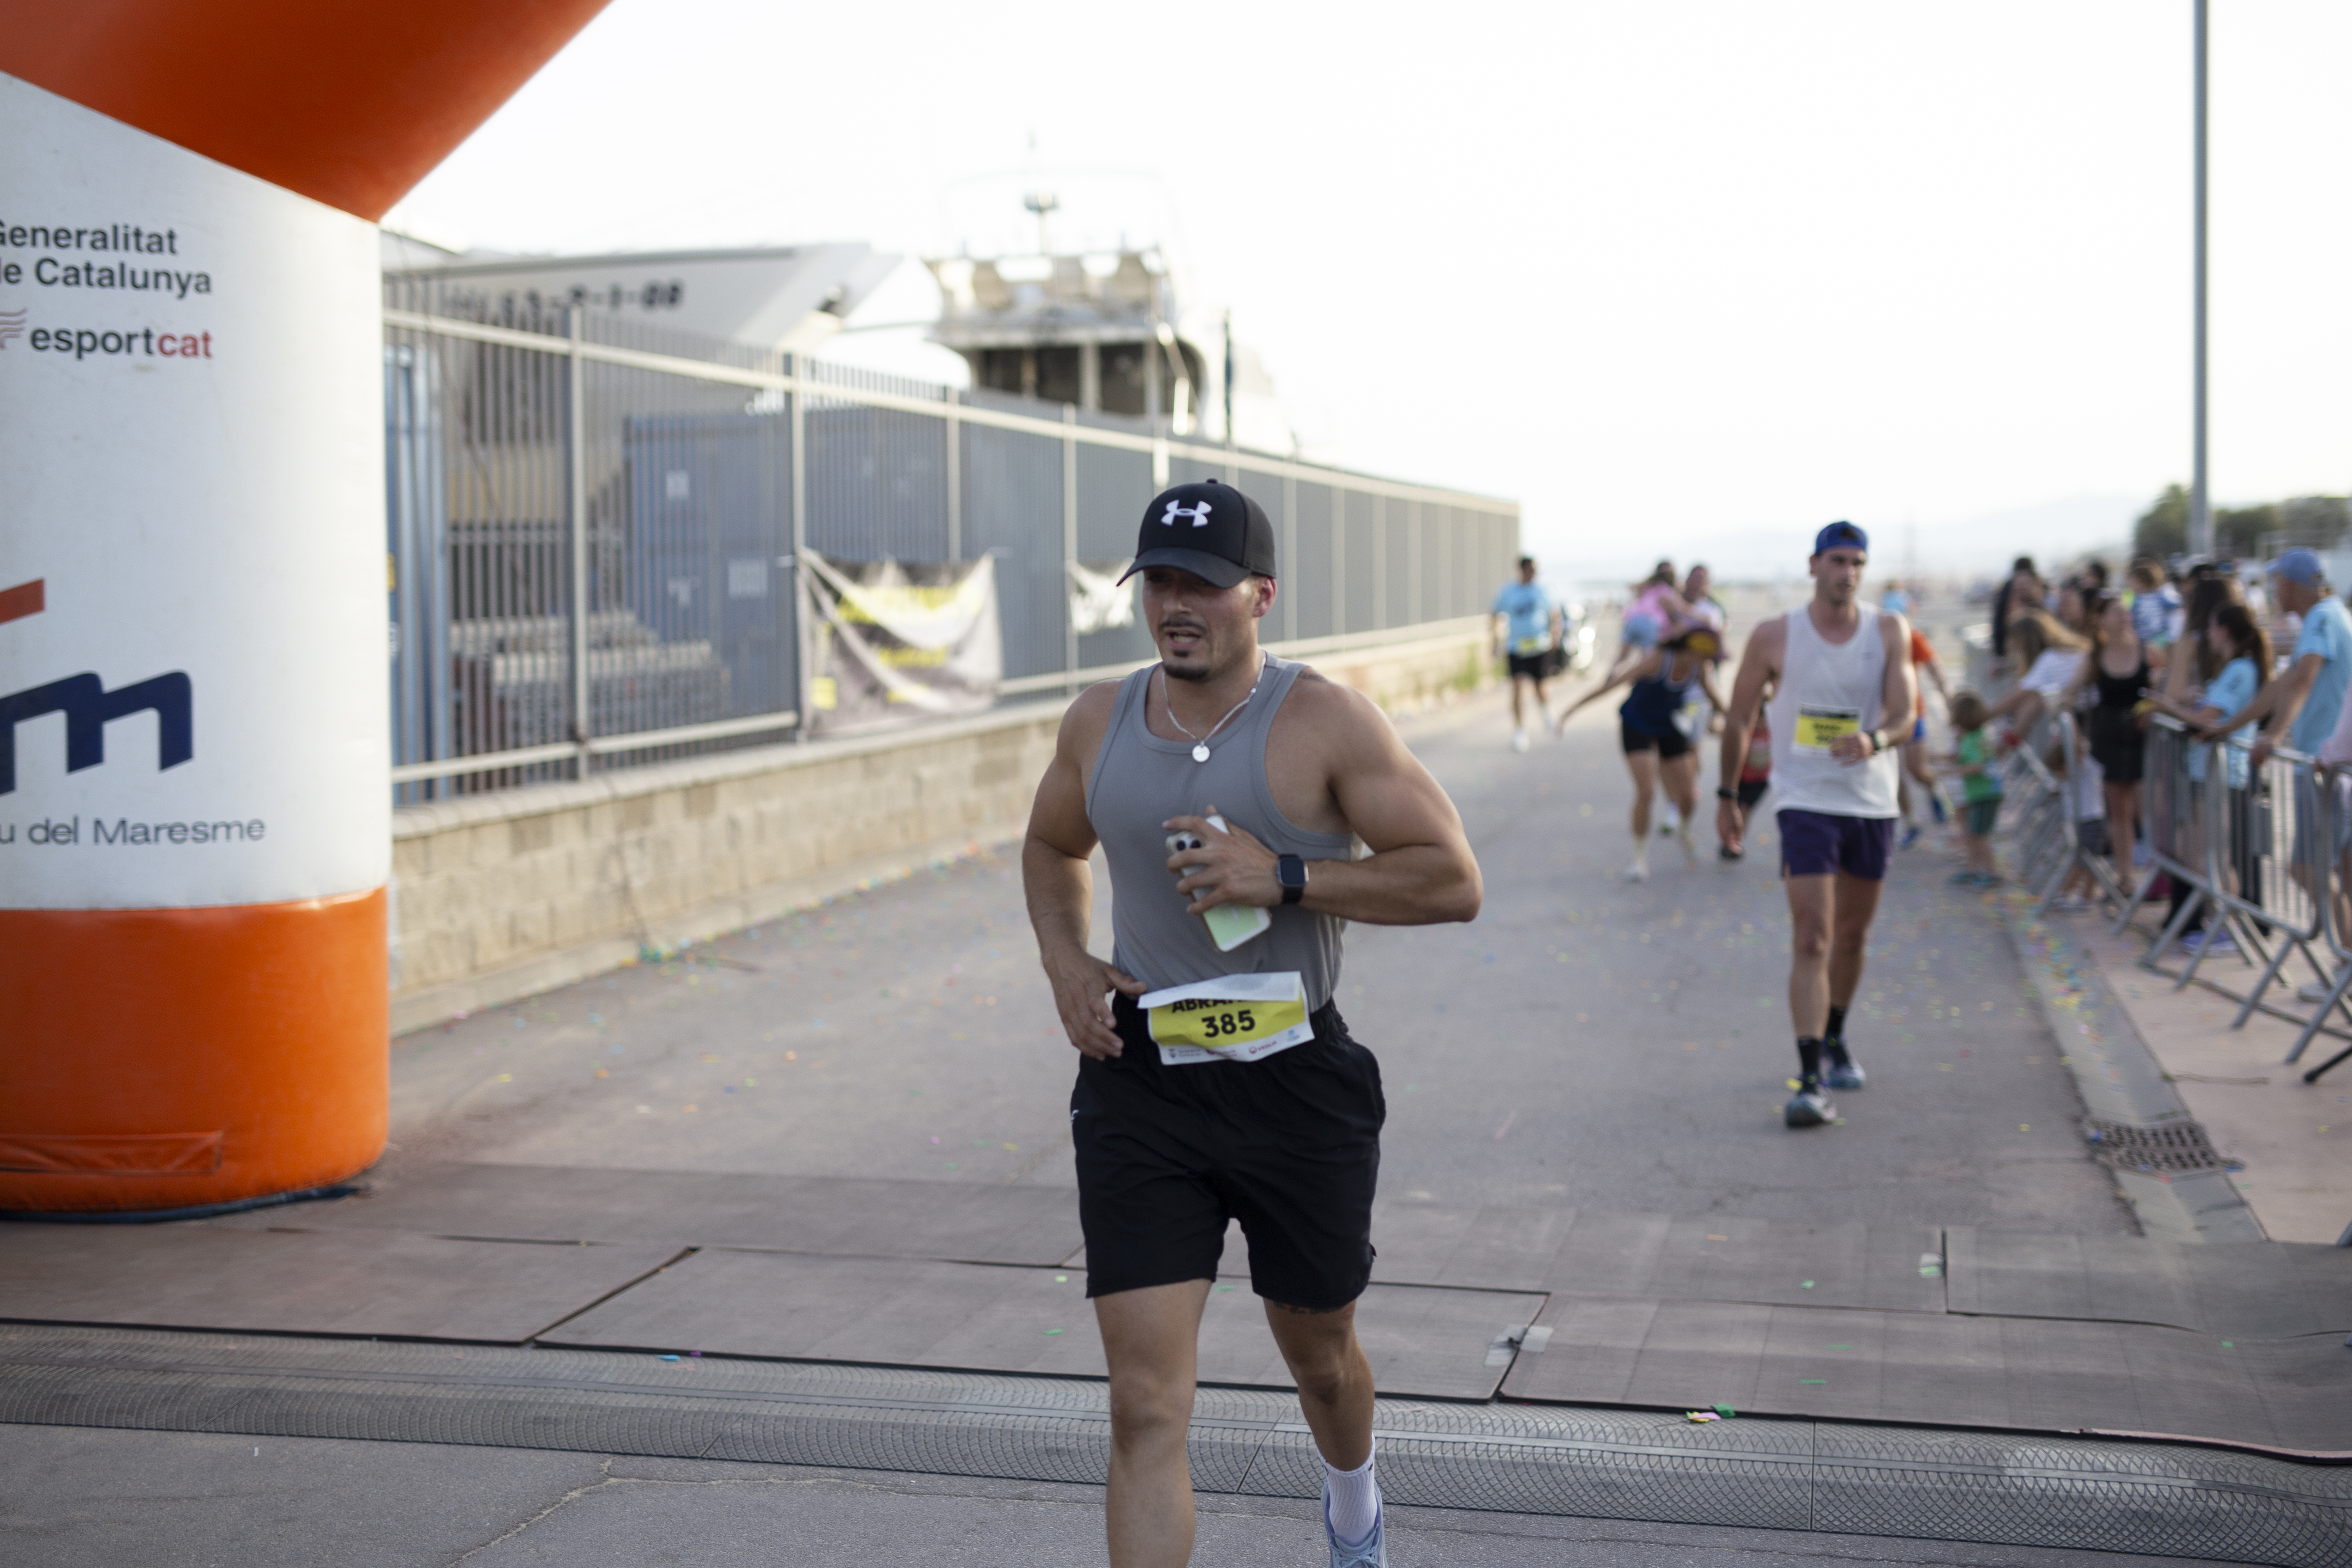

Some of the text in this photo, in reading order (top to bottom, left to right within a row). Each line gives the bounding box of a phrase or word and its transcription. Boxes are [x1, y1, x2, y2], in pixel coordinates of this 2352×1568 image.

[0, 219, 177, 254] eneralitat
[0, 257, 211, 299] e Catalunya
[30, 328, 211, 360] esportcat
[28, 815, 78, 845] del
[93, 817, 265, 846] Maresme
[1201, 1009, 1255, 1038] 385
